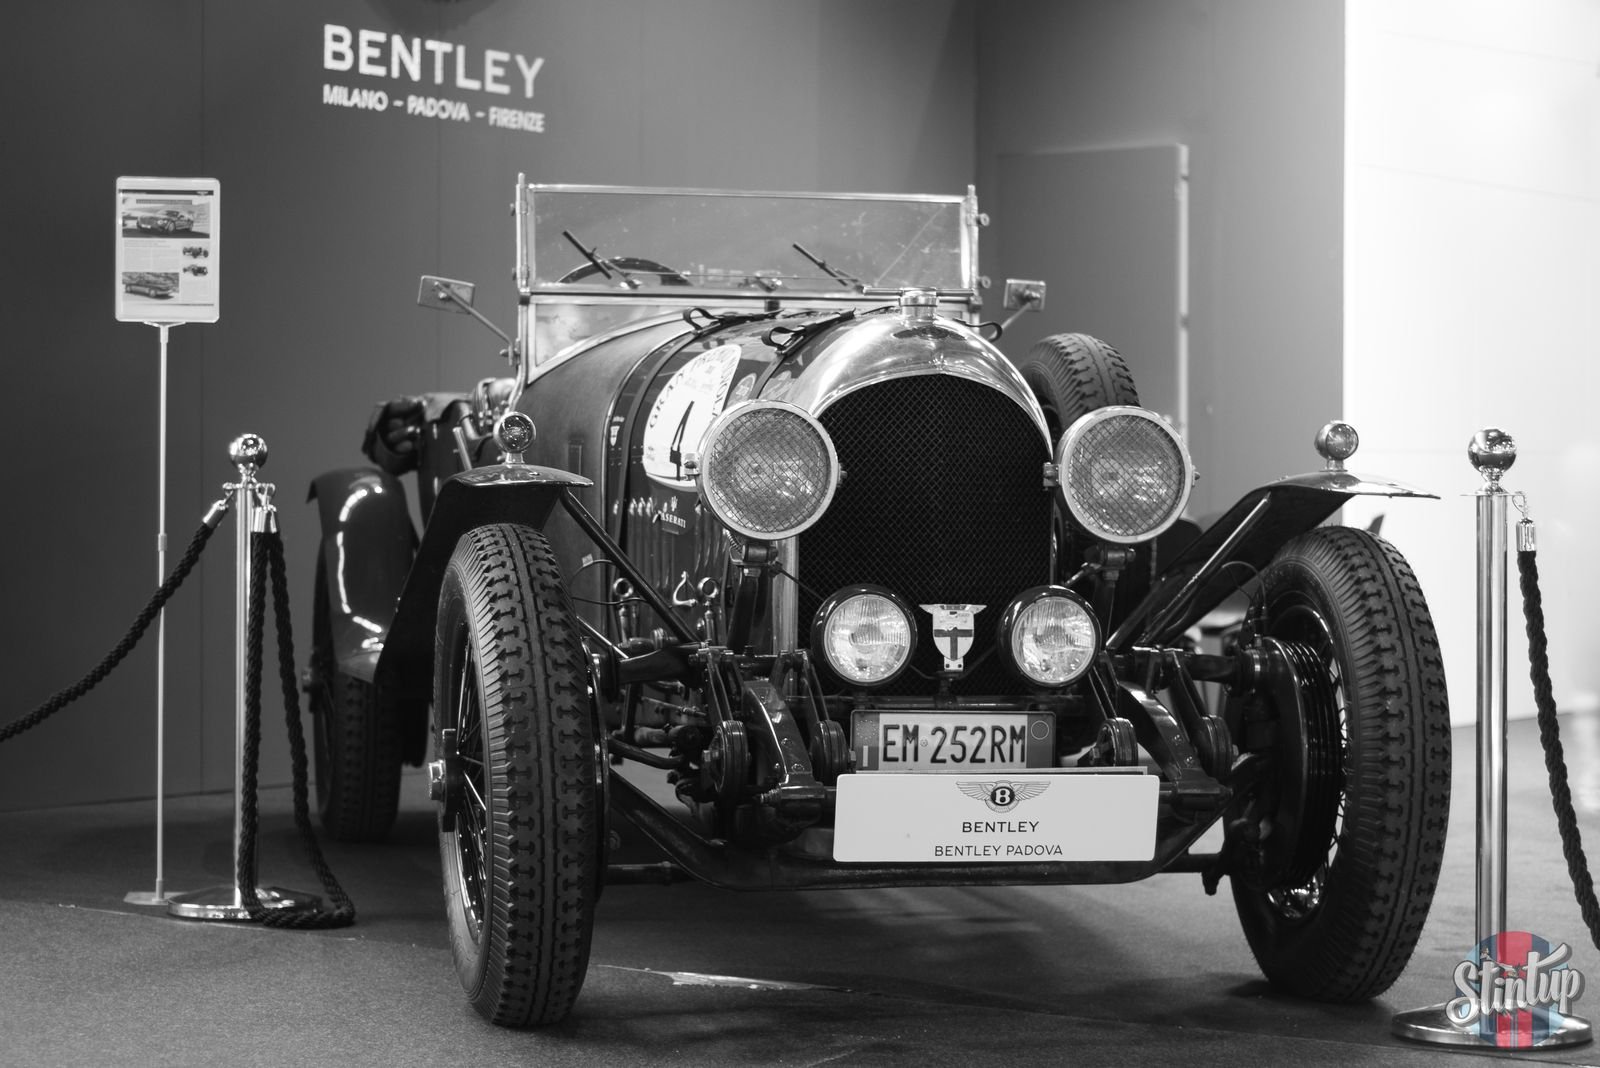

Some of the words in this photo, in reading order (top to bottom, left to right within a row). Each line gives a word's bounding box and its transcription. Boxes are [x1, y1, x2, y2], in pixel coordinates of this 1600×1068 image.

[323, 23, 545, 99] BENTLEY
[322, 83, 389, 112] MILANO
[407, 94, 470, 122] PADOVA
[488, 106, 545, 133] FIRENZE
[882, 724, 920, 763] EM
[930, 725, 1026, 764] 252RM
[962, 821, 1039, 833] BENTLEY
[934, 845, 1002, 857] BENTLEY
[1006, 844, 1063, 856] PADOVA
